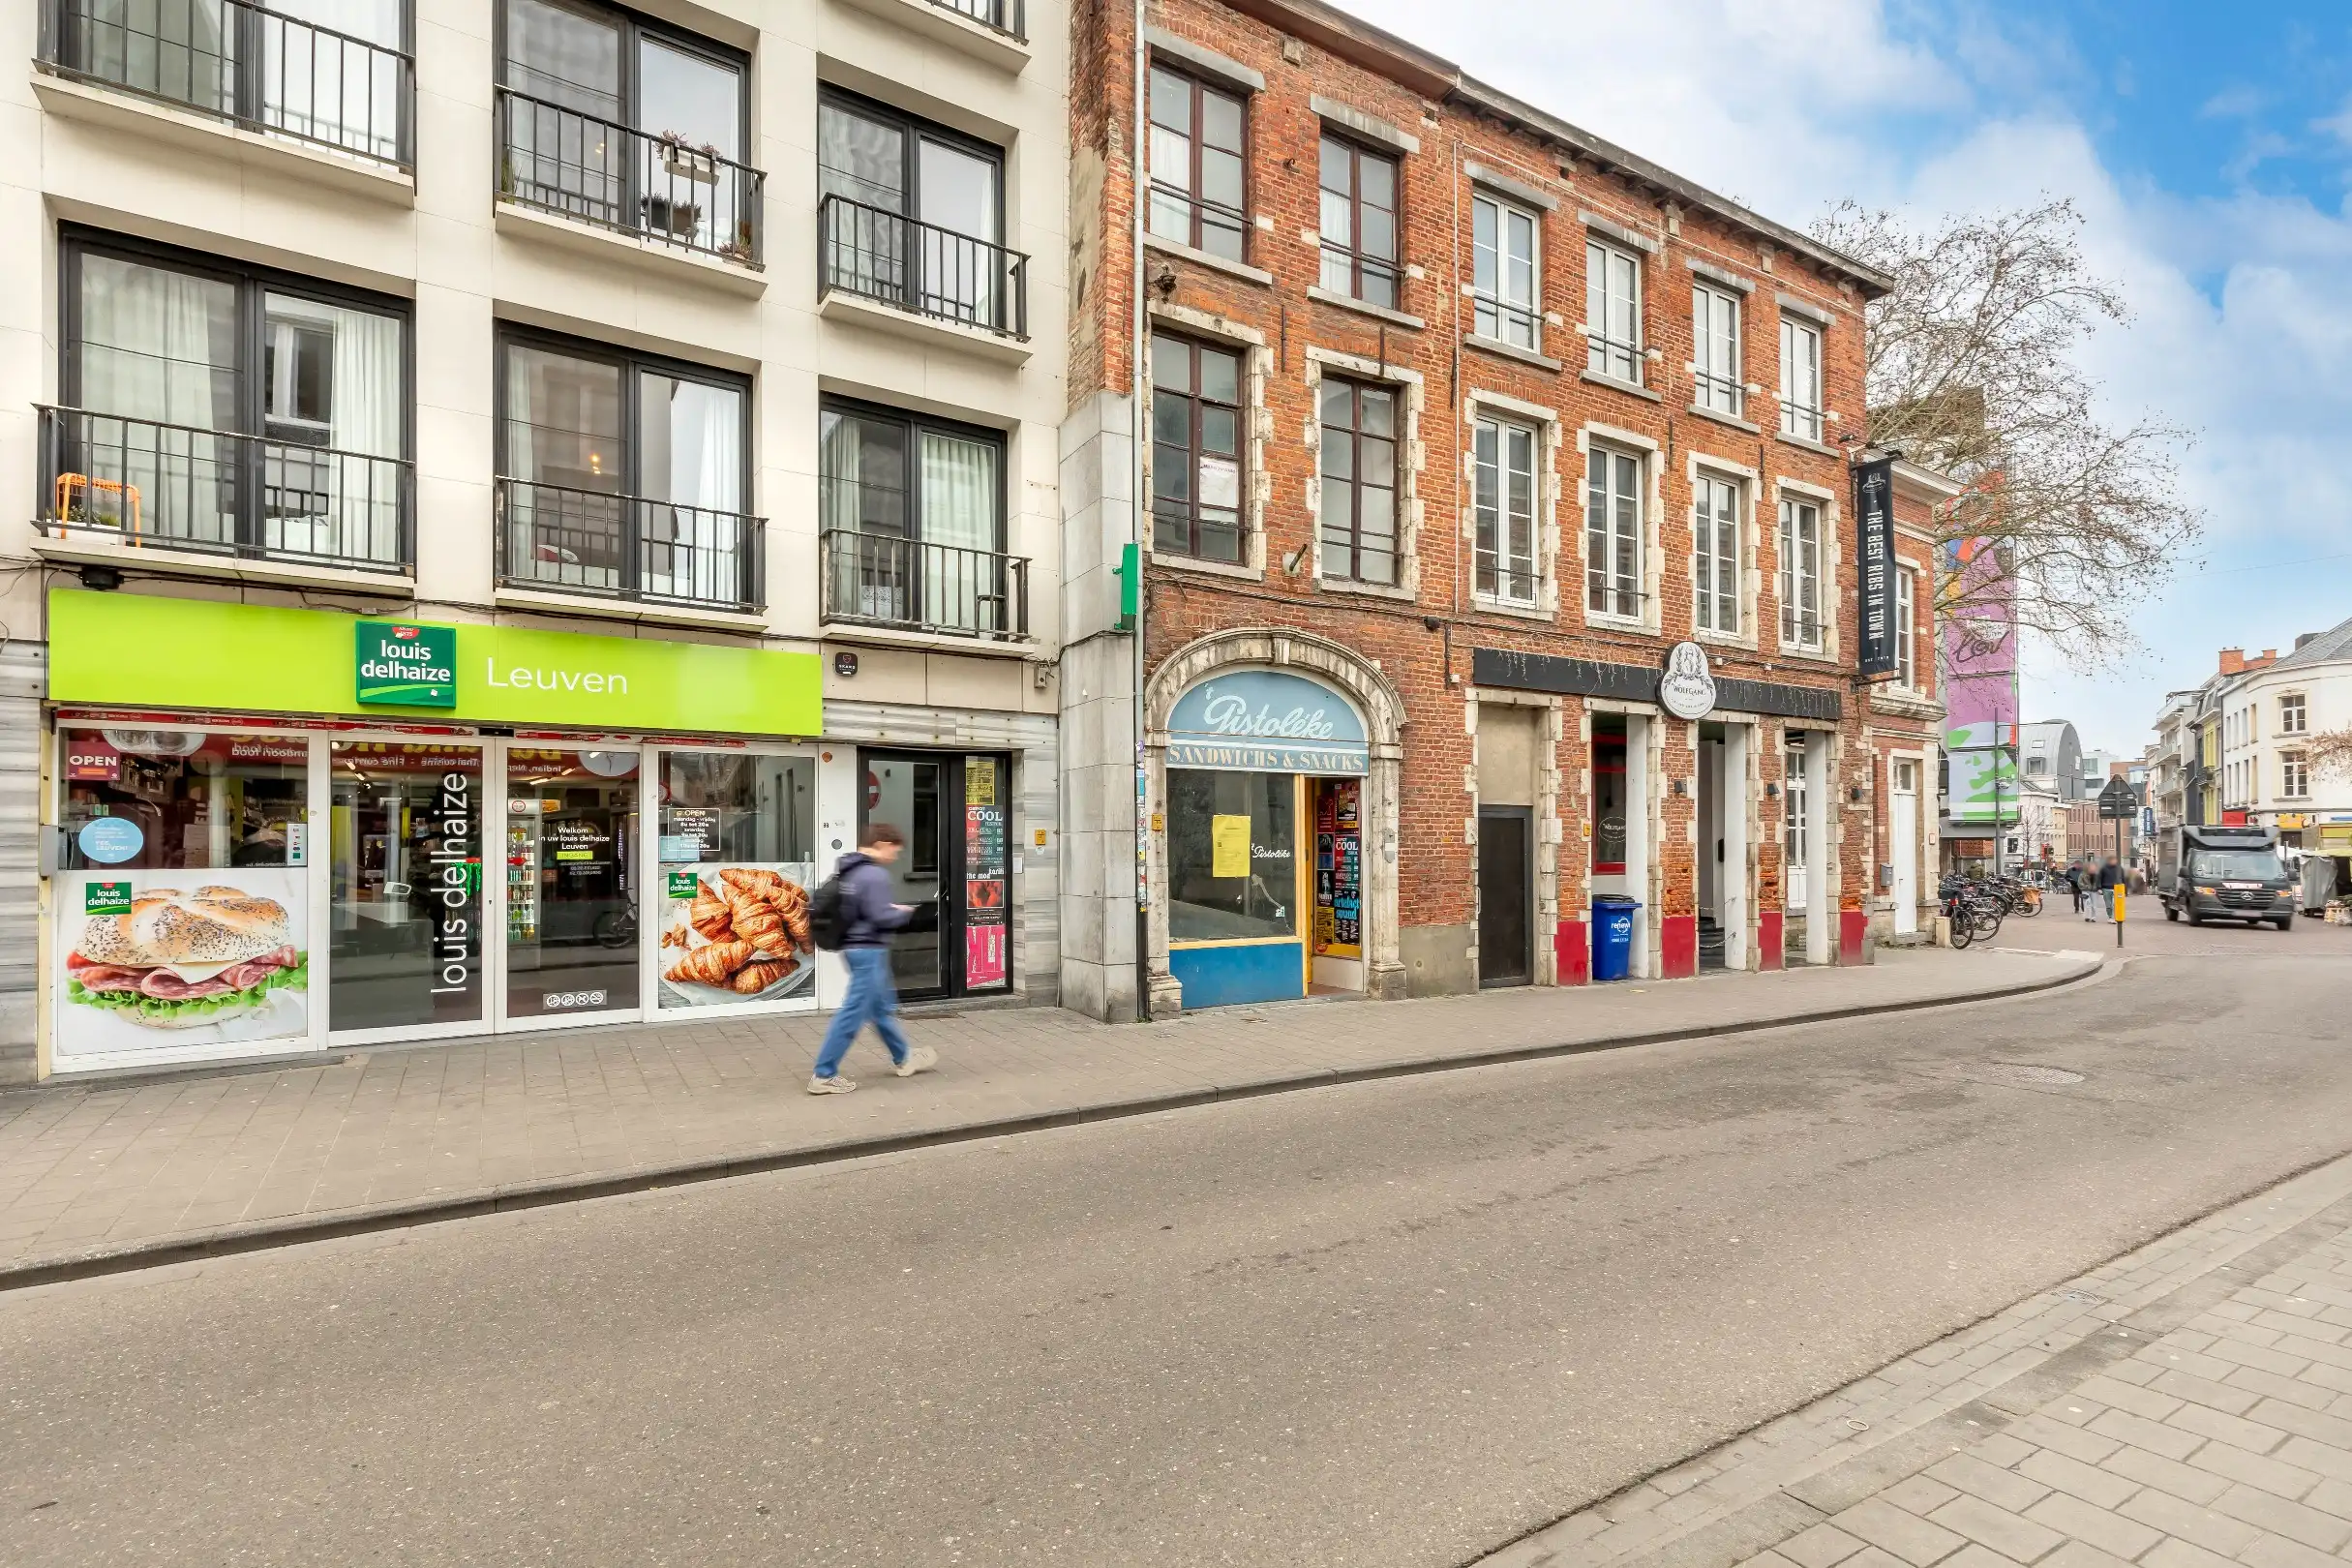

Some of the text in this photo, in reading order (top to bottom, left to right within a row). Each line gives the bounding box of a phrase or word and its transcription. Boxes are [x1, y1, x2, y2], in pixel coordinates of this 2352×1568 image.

[1867, 509, 1885, 640] THE BEST RIBS IN TOWN
[380, 639, 432, 661] louis
[360, 659, 451, 682] delhaize
[487, 656, 628, 695] Leuven
[69, 755, 117, 767] OPEN
[1169, 745, 1364, 770] SANDWICHS & SNACKS
[967, 810, 1004, 821] COOL
[1336, 841, 1359, 851] COOL
[97, 889, 121, 897] louis
[430, 772, 467, 994] louis delhaize
[87, 897, 130, 906] delhaize
